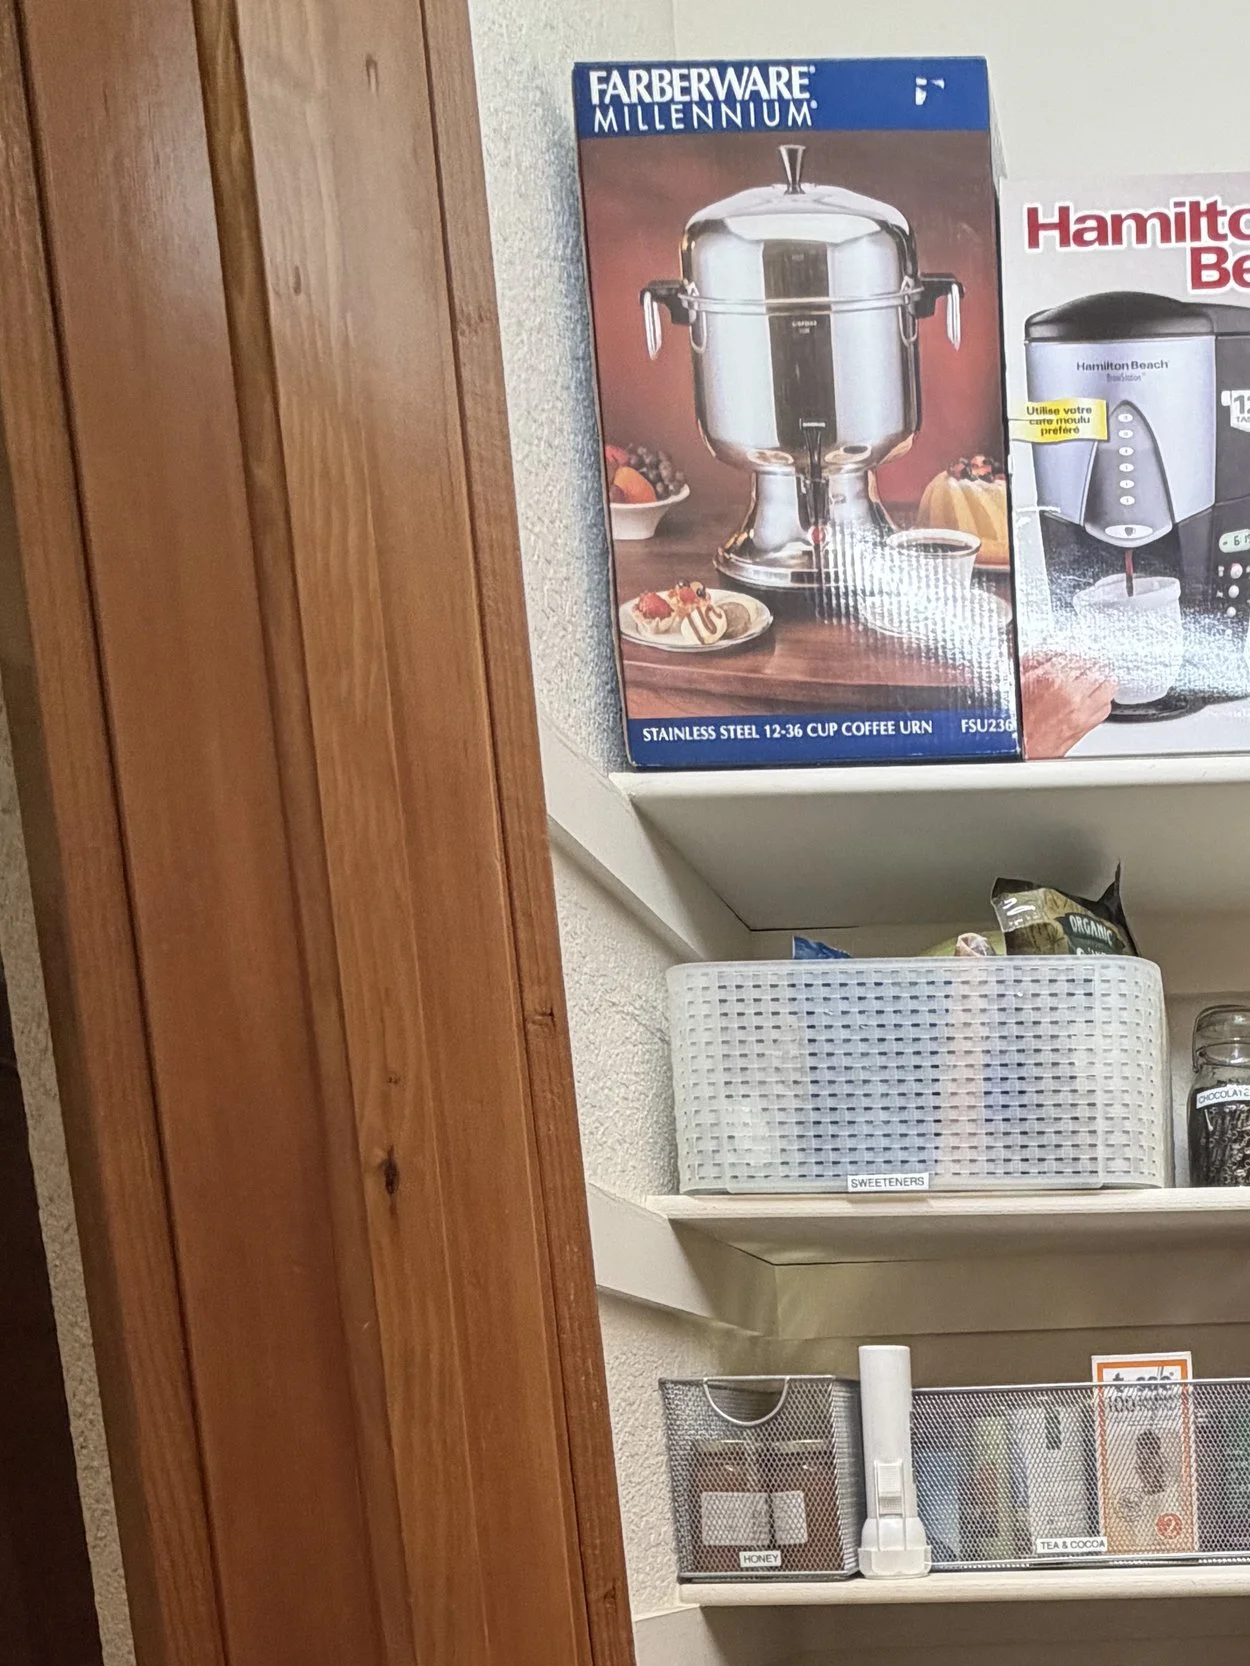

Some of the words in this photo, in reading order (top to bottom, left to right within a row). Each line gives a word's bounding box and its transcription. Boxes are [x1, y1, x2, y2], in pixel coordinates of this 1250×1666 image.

[589, 65, 811, 105] FARBERWARE
[594, 100, 812, 133] MILLENNIUM
[1076, 361, 1129, 371] Hamilton
[1131, 360, 1169, 369] Beach
[1026, 406, 1060, 416] Utilise
[1063, 407, 1093, 415] votre
[1056, 415, 1091, 425] moulu
[1040, 425, 1080, 437] préféré
[643, 726, 716, 742] STAINLESS
[720, 724, 760, 740] STEEL
[764, 723, 803, 739] 12-36
[807, 723, 838, 738] CUP
[841, 721, 896, 737] COFFEE
[899, 720, 932, 735] URN
[960, 718, 1014, 734] FSU236
[1069, 914, 1113, 946] ORGANIC
[1198, 1088, 1250, 1104] CHOCOLATE
[851, 1176, 925, 1189] SWEETENERS
[1040, 1541, 1059, 1550] TEA
[1061, 1540, 1069, 1549] &
[1070, 1539, 1106, 1549] COCOA
[743, 1553, 779, 1564] HONEY
